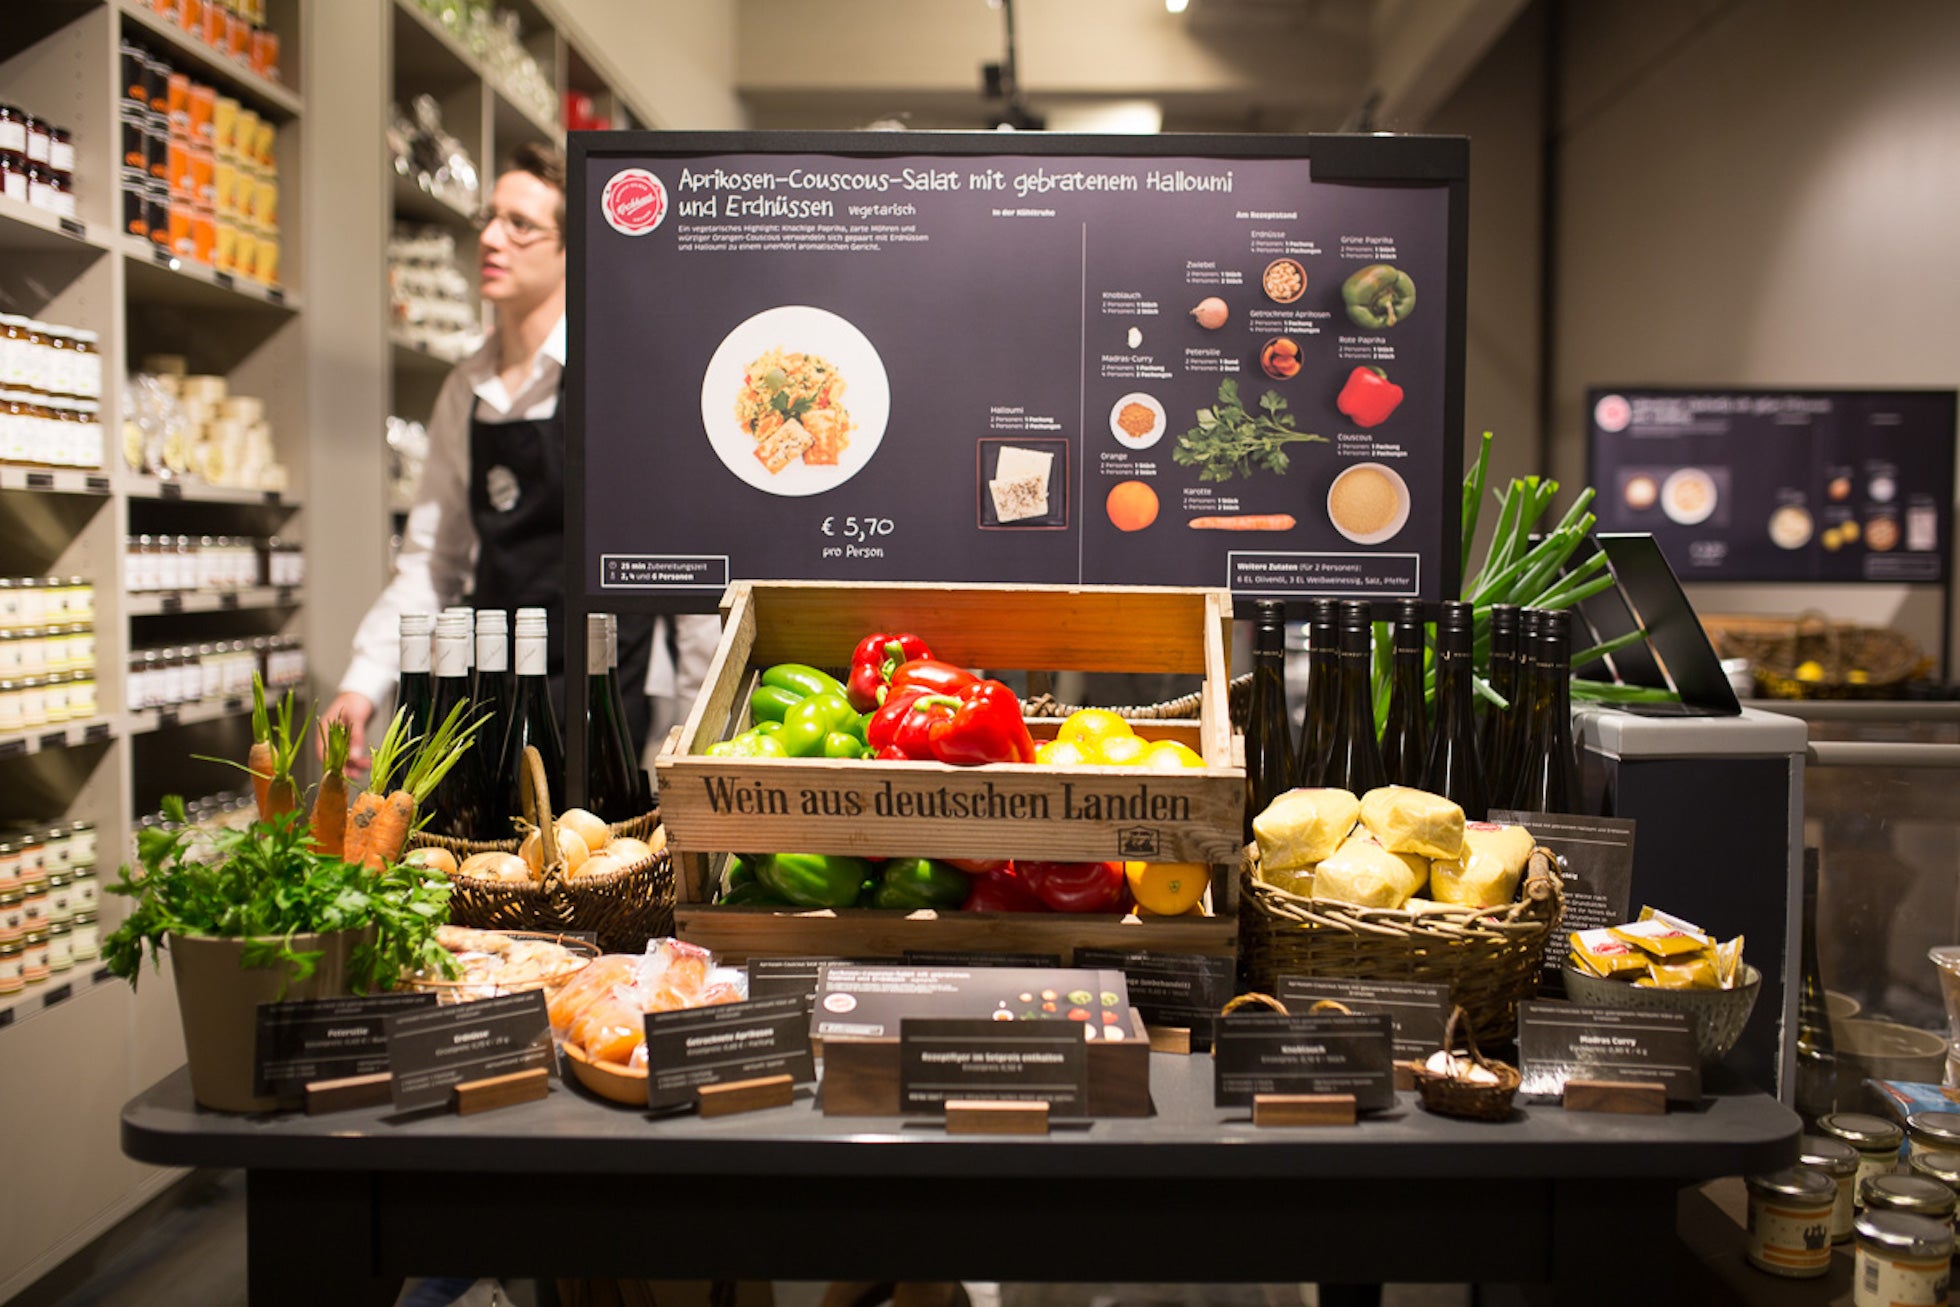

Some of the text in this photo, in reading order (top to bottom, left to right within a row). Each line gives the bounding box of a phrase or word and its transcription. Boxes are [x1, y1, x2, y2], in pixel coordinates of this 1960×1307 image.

[678, 167, 1233, 198] Aprikosen-Couscous-Salat mit gebratenem Halloumi
[678, 193, 917, 219] und Erdnüssen vegetarisch
[992, 208, 1055, 217] In der Kühltruhe
[1236, 210, 1297, 220] Am Rezeptstand
[678, 225, 916, 234] Ein vegetarisches Highlight: Knackige Paprika, zarte Möhren und
[678, 233, 929, 242] würziger Orangen-Couscous verwandeln sich gepaart mit Erdnüssen
[678, 243, 881, 251] und Halloumi zu einem unerhört aromatischen Gericht.
[821, 516, 895, 542] € 5,70
[822, 543, 885, 559] pro Person
[631, 562, 646, 572] min
[1237, 562, 1268, 572] Weitere
[1269, 562, 1298, 572] Zutaten
[636, 572, 651, 581] und
[658, 572, 694, 581] Personen
[700, 775, 1191, 822] Wein aus deutschen Landen
[1579, 1035, 1637, 1047] Madras Curry
